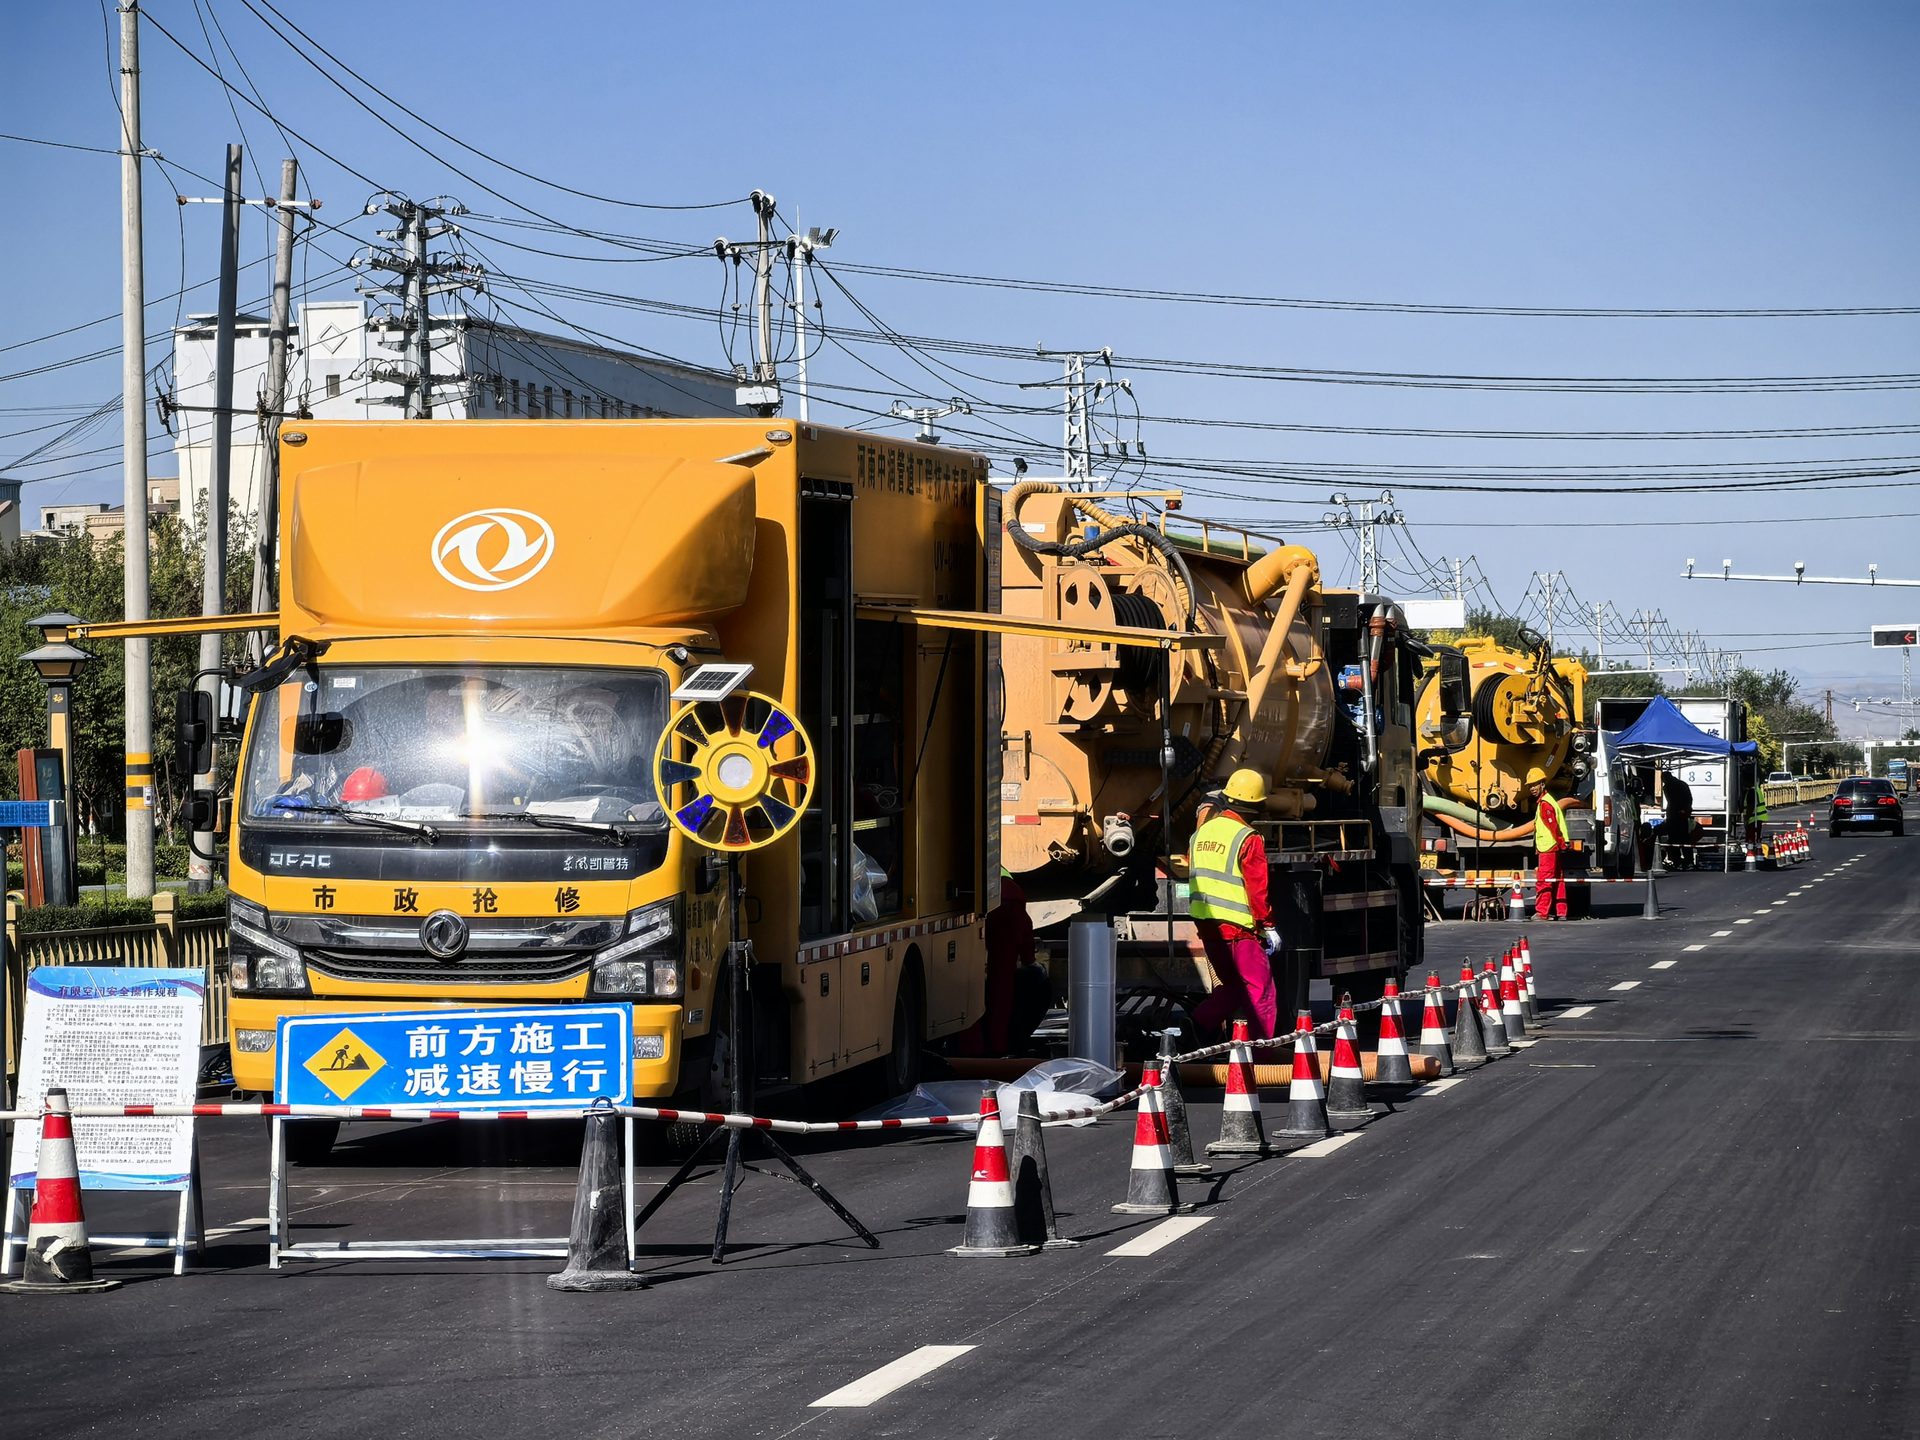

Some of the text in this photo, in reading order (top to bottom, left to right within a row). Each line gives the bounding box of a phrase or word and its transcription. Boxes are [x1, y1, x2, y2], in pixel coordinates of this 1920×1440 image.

[563, 856, 629, 871] 东风凯普特
[312, 885, 581, 913] 市政抢修
[58, 985, 179, 998] 有限空间安全操作规程
[404, 1022, 608, 1058] 前方施工
[403, 1059, 608, 1098] 减速慢行
